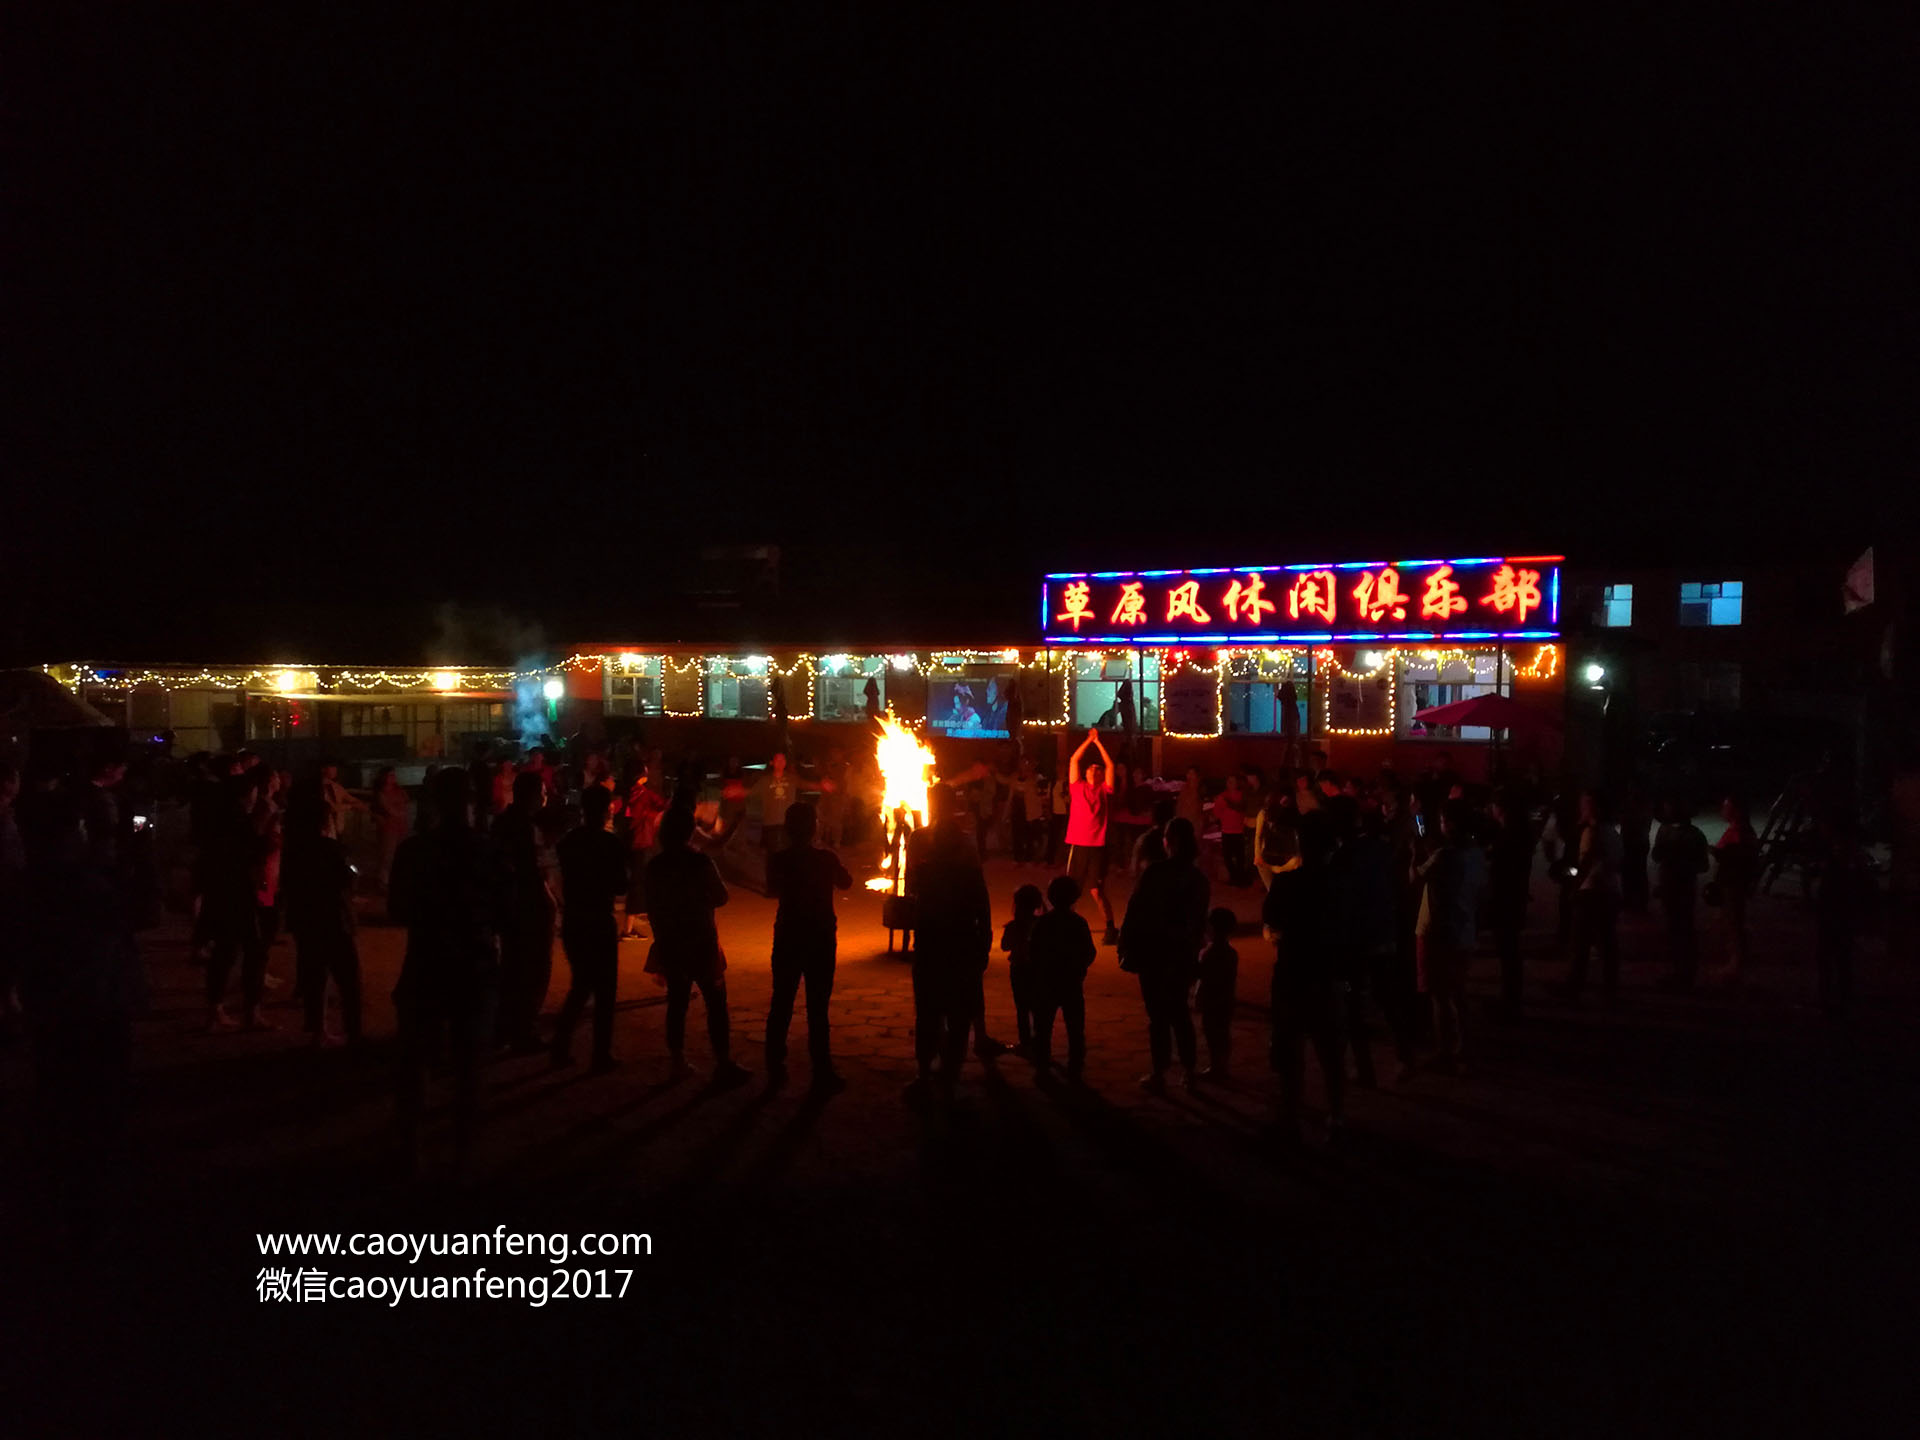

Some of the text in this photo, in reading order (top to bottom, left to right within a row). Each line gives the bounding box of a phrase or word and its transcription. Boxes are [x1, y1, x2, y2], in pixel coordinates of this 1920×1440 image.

[1056, 564, 1542, 630] 草原风休闲俱乐部
